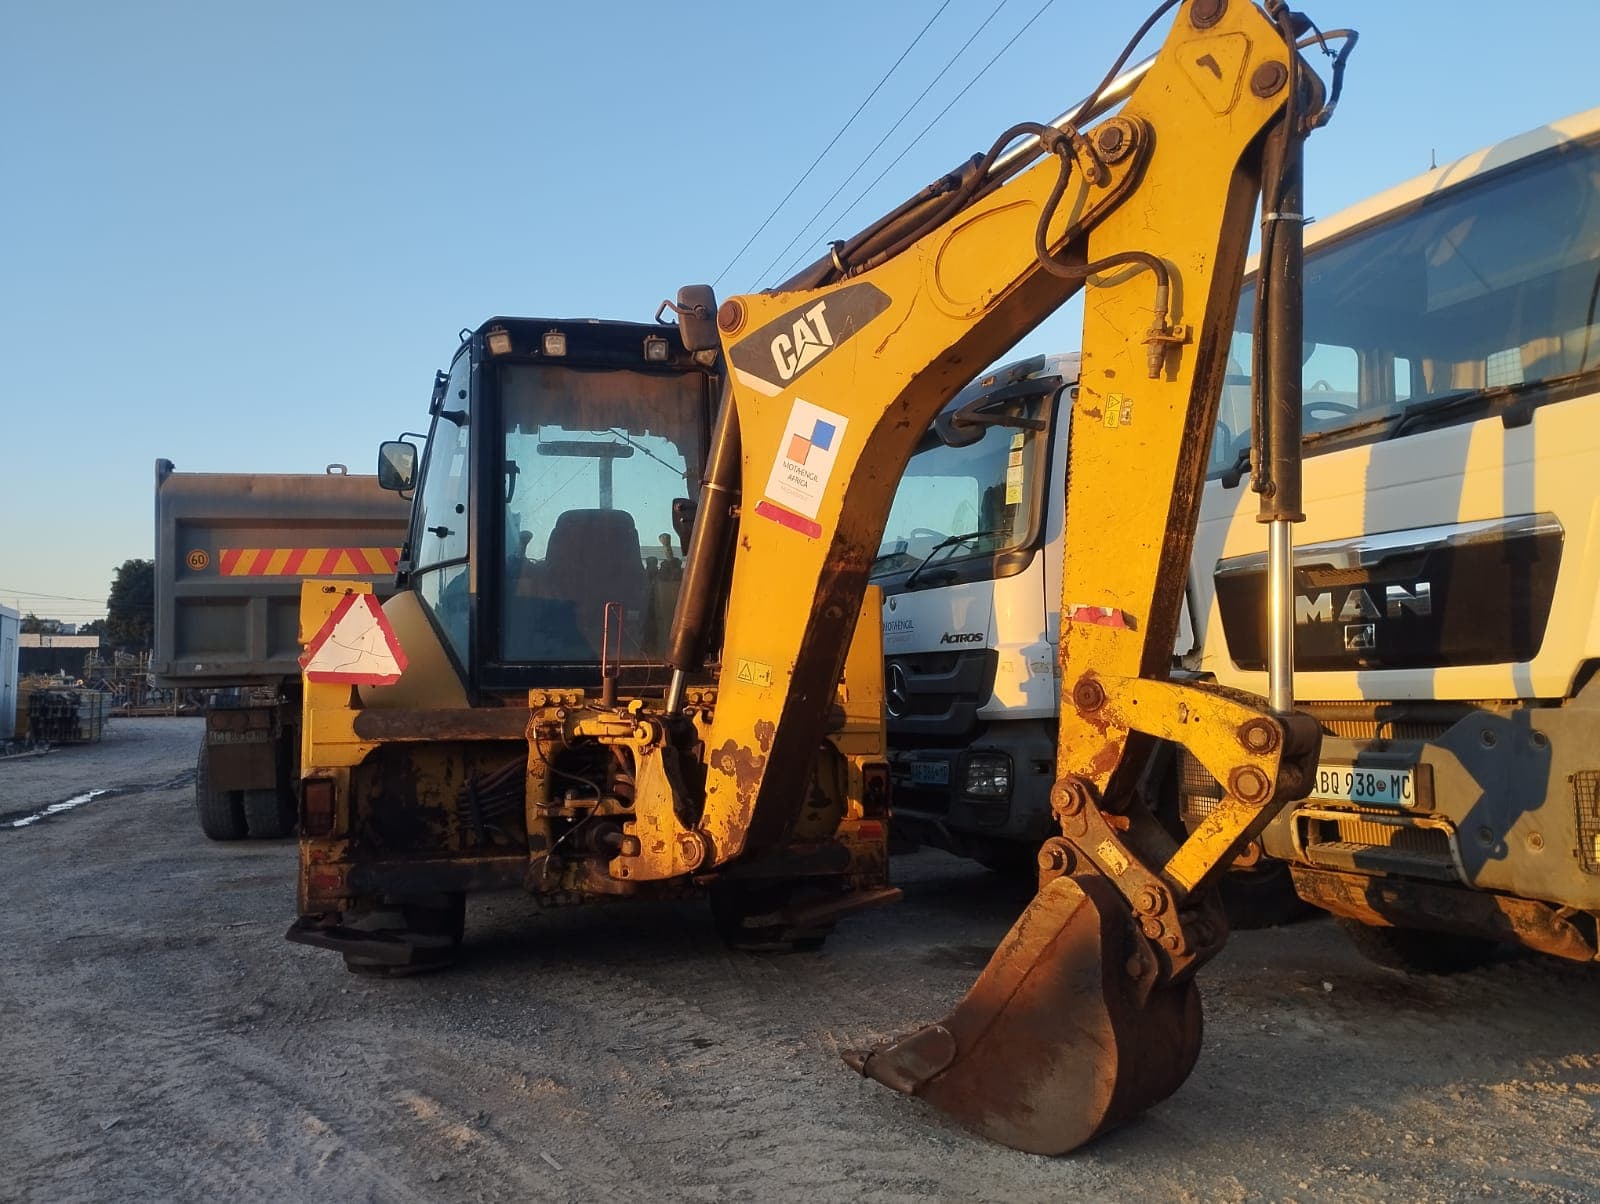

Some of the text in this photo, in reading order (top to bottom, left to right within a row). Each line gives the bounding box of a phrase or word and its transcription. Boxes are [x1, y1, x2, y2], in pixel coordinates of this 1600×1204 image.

[771, 300, 834, 380] CAT
[191, 554, 205, 566] 60
[1295, 582, 1432, 625] MAN
[1345, 772, 1376, 797] 938
[1390, 774, 1412, 799] MC
